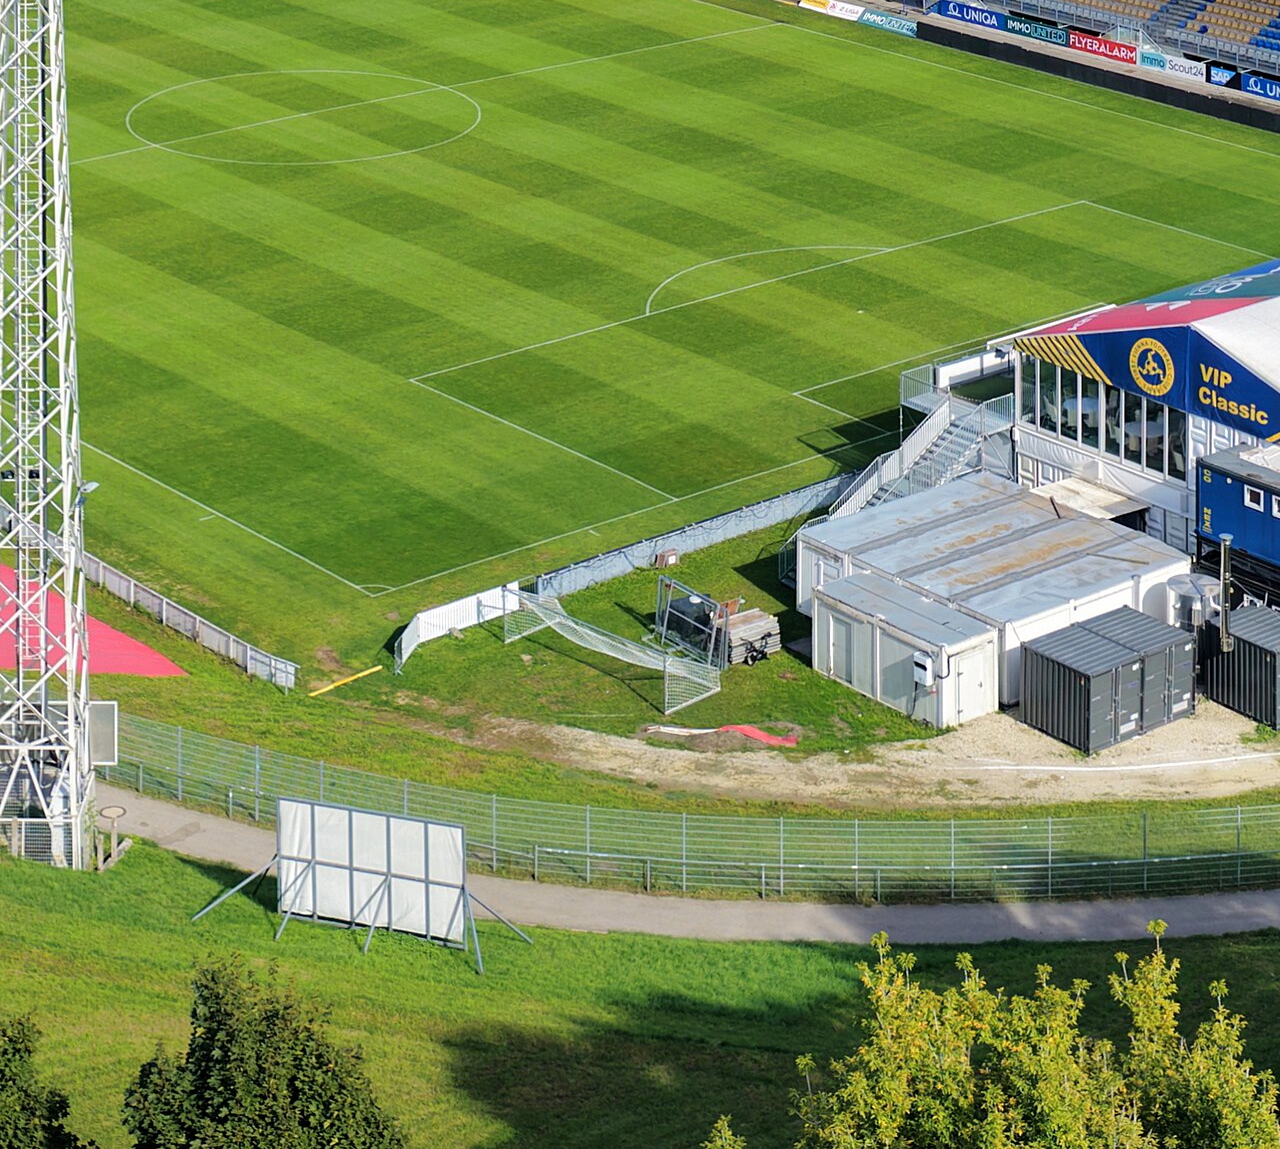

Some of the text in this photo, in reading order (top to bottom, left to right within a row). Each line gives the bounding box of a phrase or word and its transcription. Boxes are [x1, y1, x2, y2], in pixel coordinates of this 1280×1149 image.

[963, 7, 998, 27] UNIQA
[1069, 34, 1136, 62] FLYERALARM
[1141, 55, 1204, 78] Immo Scout24
[1210, 69, 1230, 84] SAP
[1199, 362, 1233, 389] VIP
[1197, 385, 1269, 426] Classic
